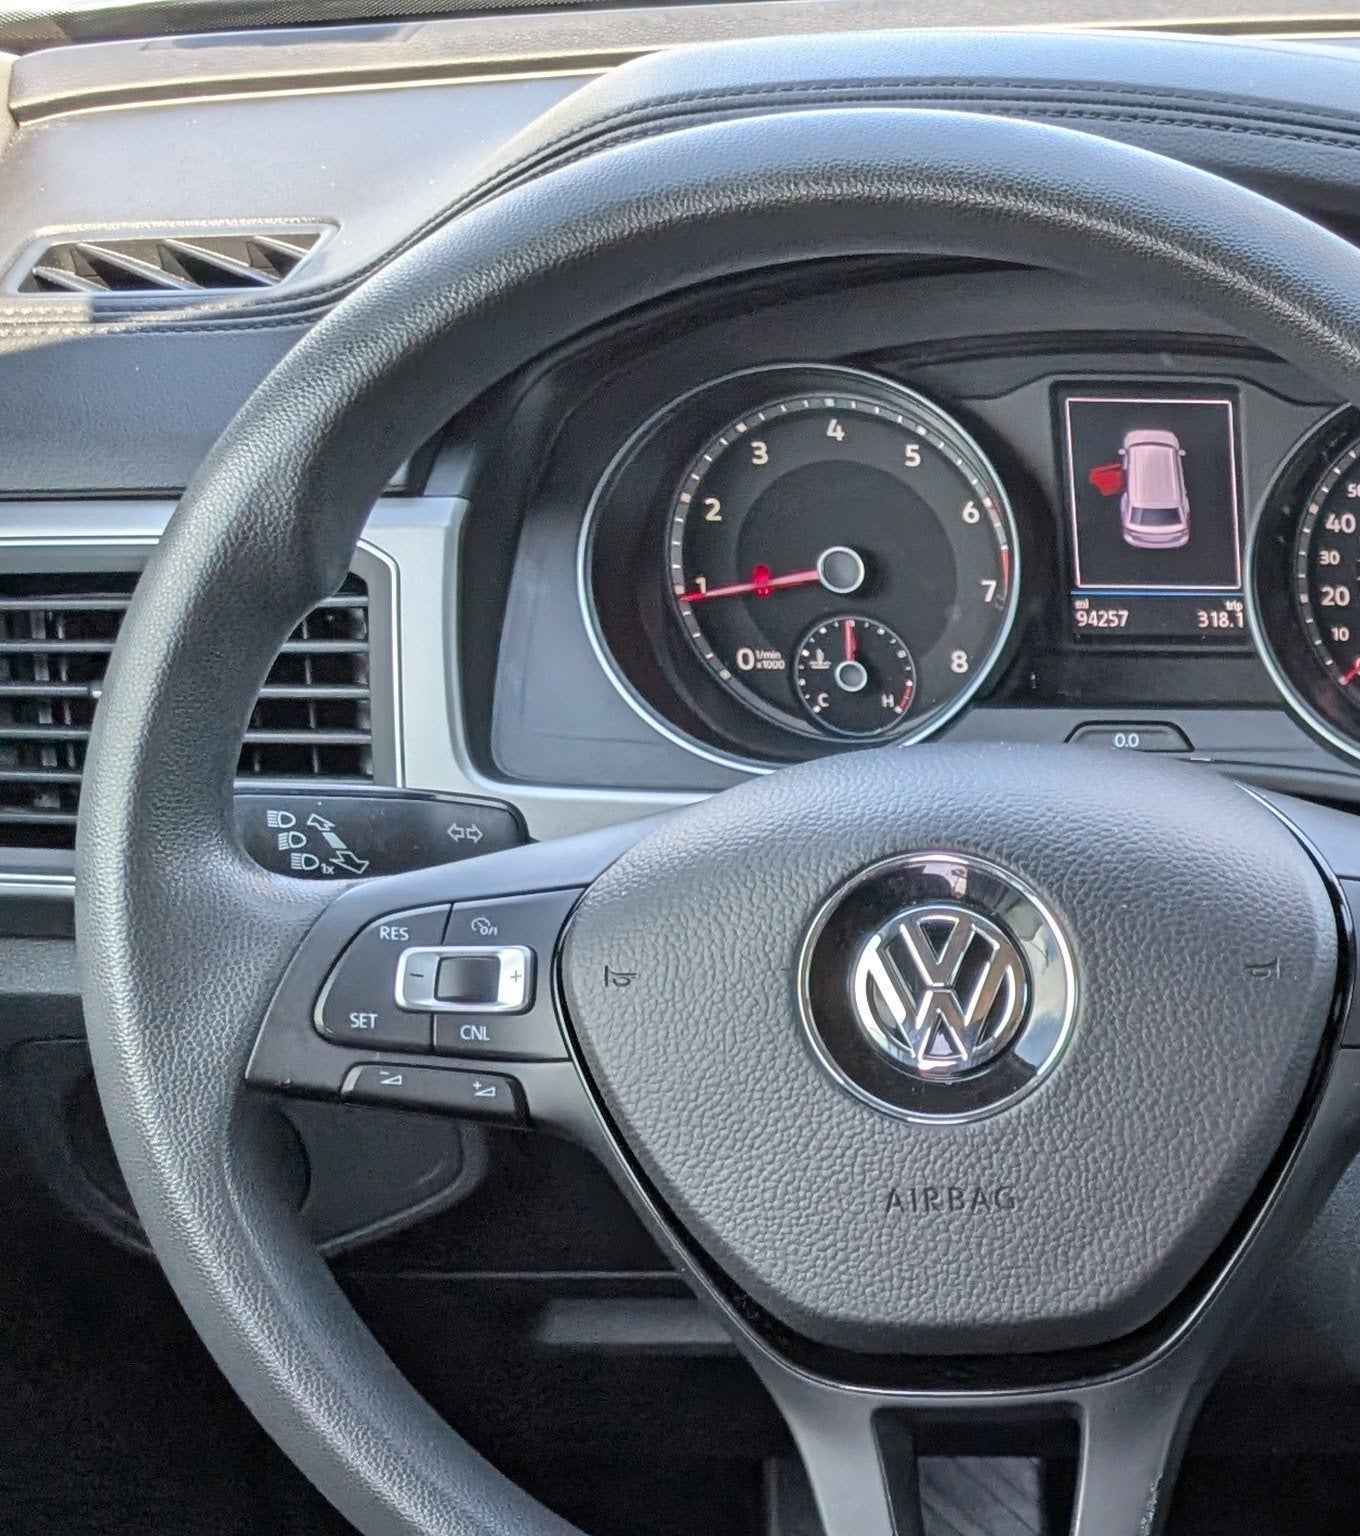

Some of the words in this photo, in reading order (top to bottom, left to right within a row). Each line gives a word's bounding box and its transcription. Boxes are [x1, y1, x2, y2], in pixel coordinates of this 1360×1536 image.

[827, 420, 844, 441] 4
[752, 441, 768, 464] 3
[905, 444, 921, 467] 5
[705, 498, 722, 522] 2
[962, 502, 980, 524] 6
[1325, 513, 1356, 533] 40
[1318, 550, 1340, 566] 30
[695, 576, 708, 595] 1
[980, 579, 997, 603] 7
[1320, 586, 1350, 607] 20
[1224, 600, 1244, 612] trip
[1075, 610, 1129, 627] 94257
[1196, 610, 1245, 628] 318.1
[1331, 627, 1350, 641] 10
[737, 647, 755, 670] 0
[756, 659, 785, 670] x1000
[950, 649, 968, 674] 8
[817, 692, 830, 708] C
[880, 693, 895, 708] H
[1113, 732, 1140, 748] 0.0
[379, 925, 410, 942] RES
[348, 1012, 379, 1029] SET
[459, 1024, 491, 1042] CNL
[886, 1185, 1017, 1214] AIRBAG
